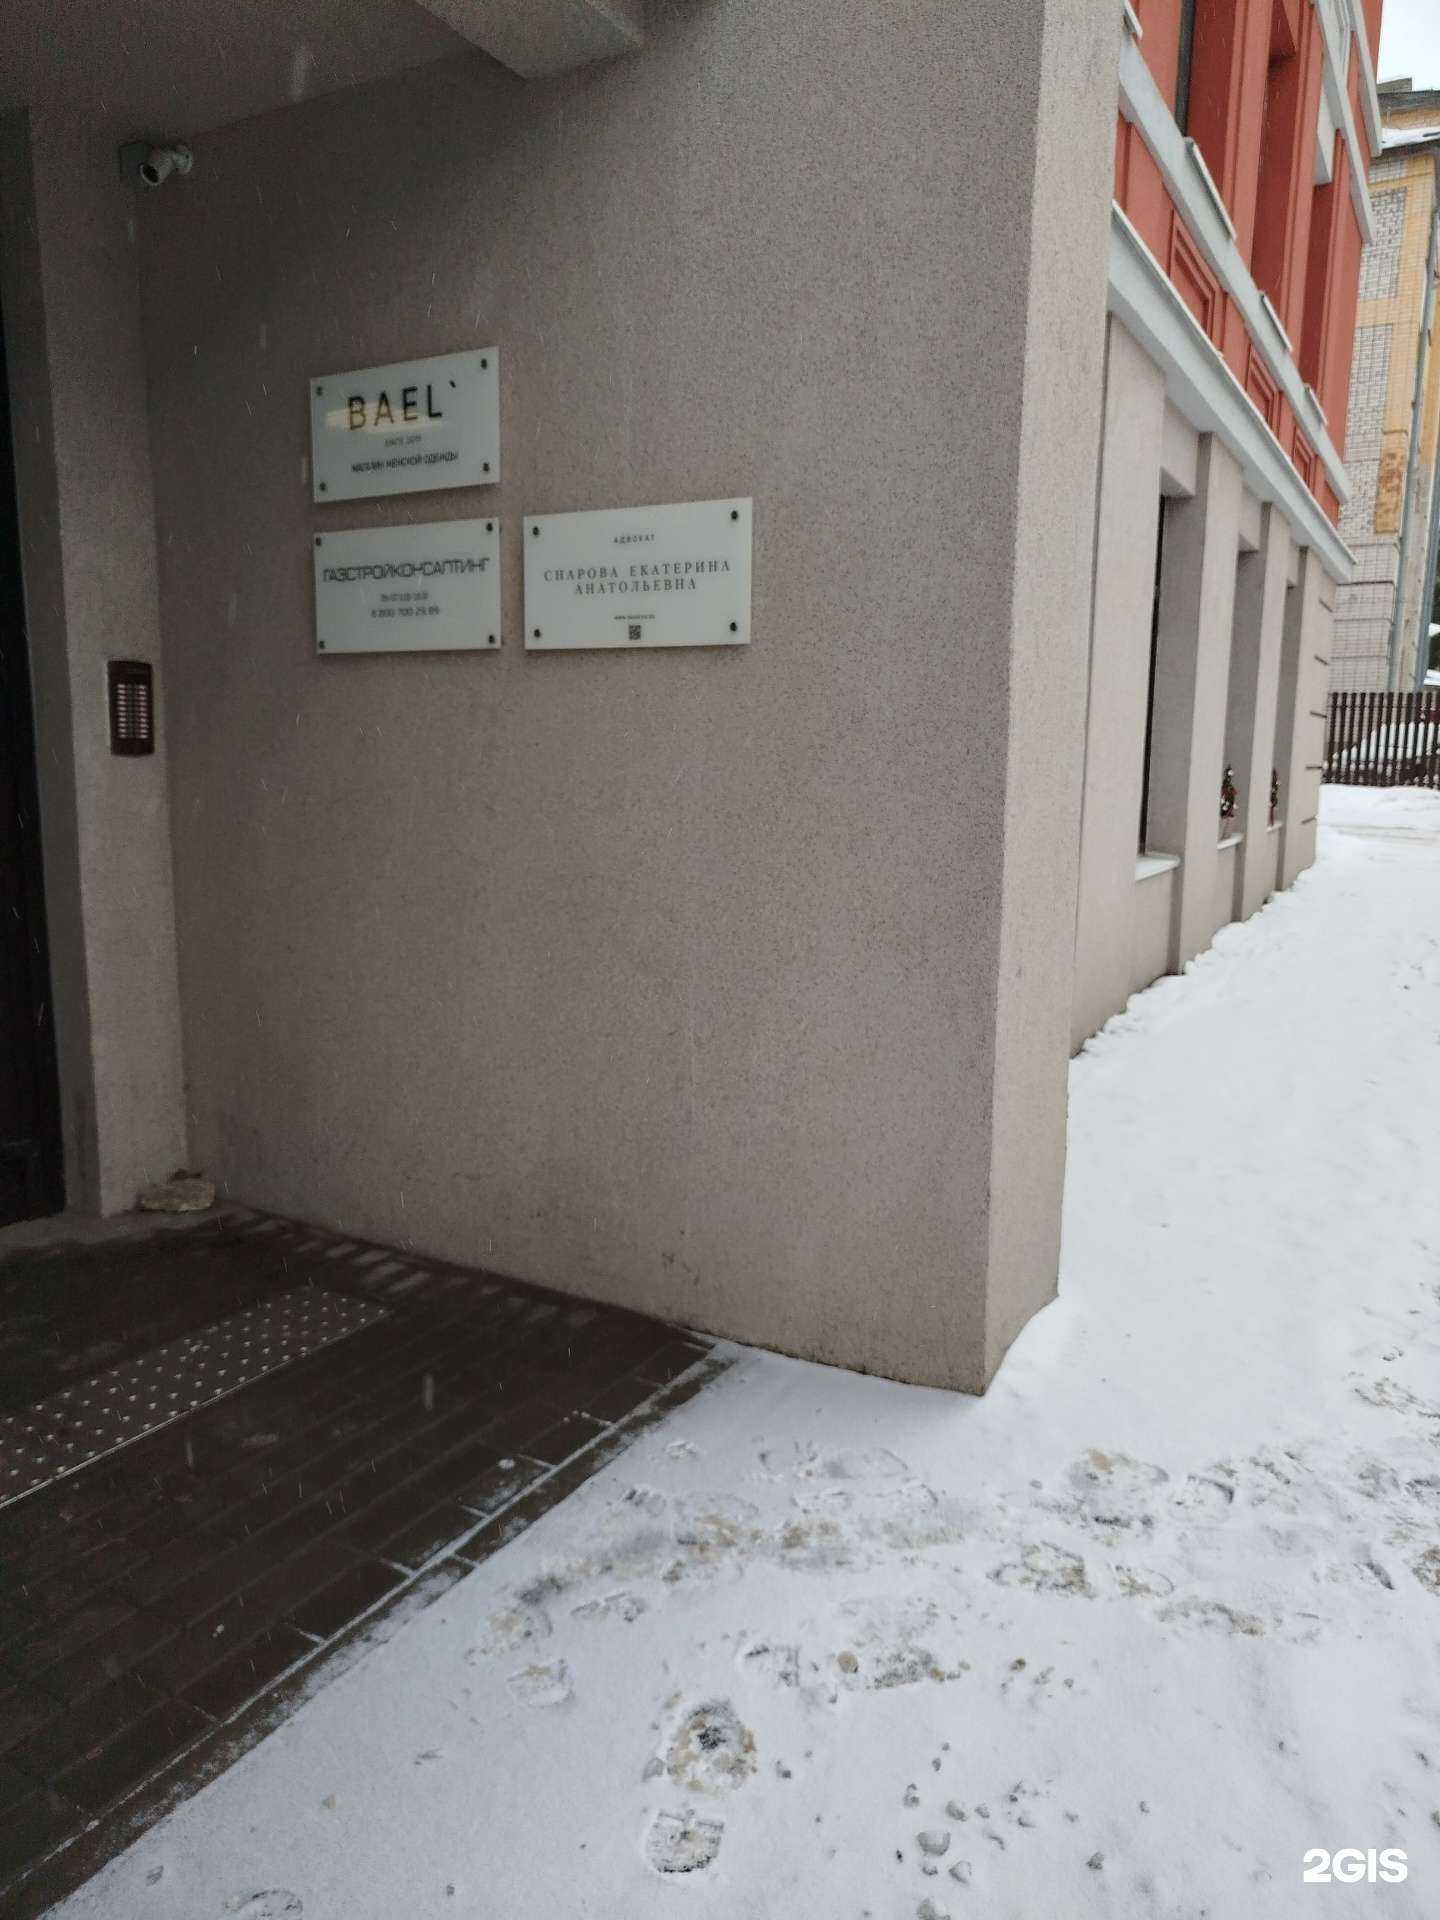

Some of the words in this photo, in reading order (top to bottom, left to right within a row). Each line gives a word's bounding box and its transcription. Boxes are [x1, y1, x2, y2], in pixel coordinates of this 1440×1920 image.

[613, 534, 656, 545] АДВОКАТ
[322, 557, 490, 582] ГАЗСТРОЙКОНСАЛТИНГ
[629, 559, 731, 577] ЕКАТЕРИНА
[574, 577, 698, 596] АНАТОЛЬЕВНА
